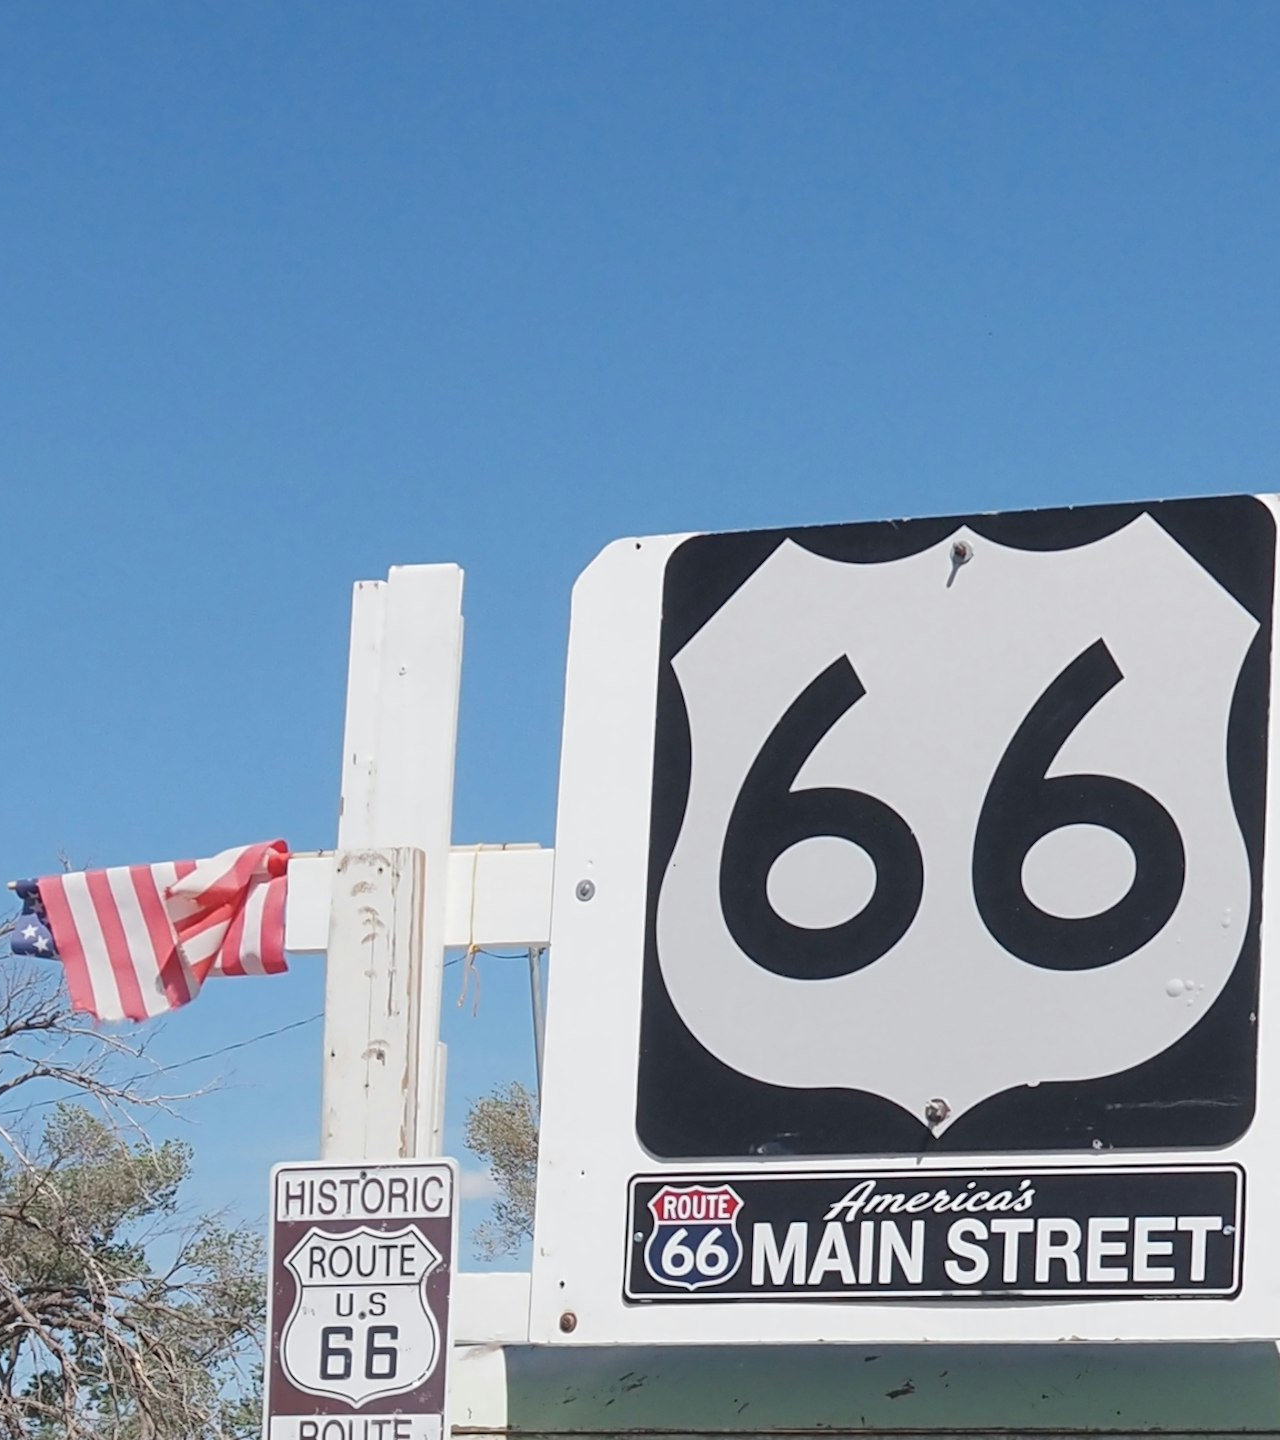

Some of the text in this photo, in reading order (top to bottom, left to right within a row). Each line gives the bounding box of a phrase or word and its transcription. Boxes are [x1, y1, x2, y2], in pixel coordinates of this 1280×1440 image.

[719, 638, 1185, 980] 66
[285, 1175, 444, 1216] HISTORIC
[663, 1193, 730, 1220] ROUTE
[823, 1179, 1036, 1222] America's
[309, 1244, 416, 1278] ROUTE
[660, 1228, 730, 1277] 66
[751, 1216, 1223, 1286] MAIN STREET
[320, 1325, 399, 1380] 66
